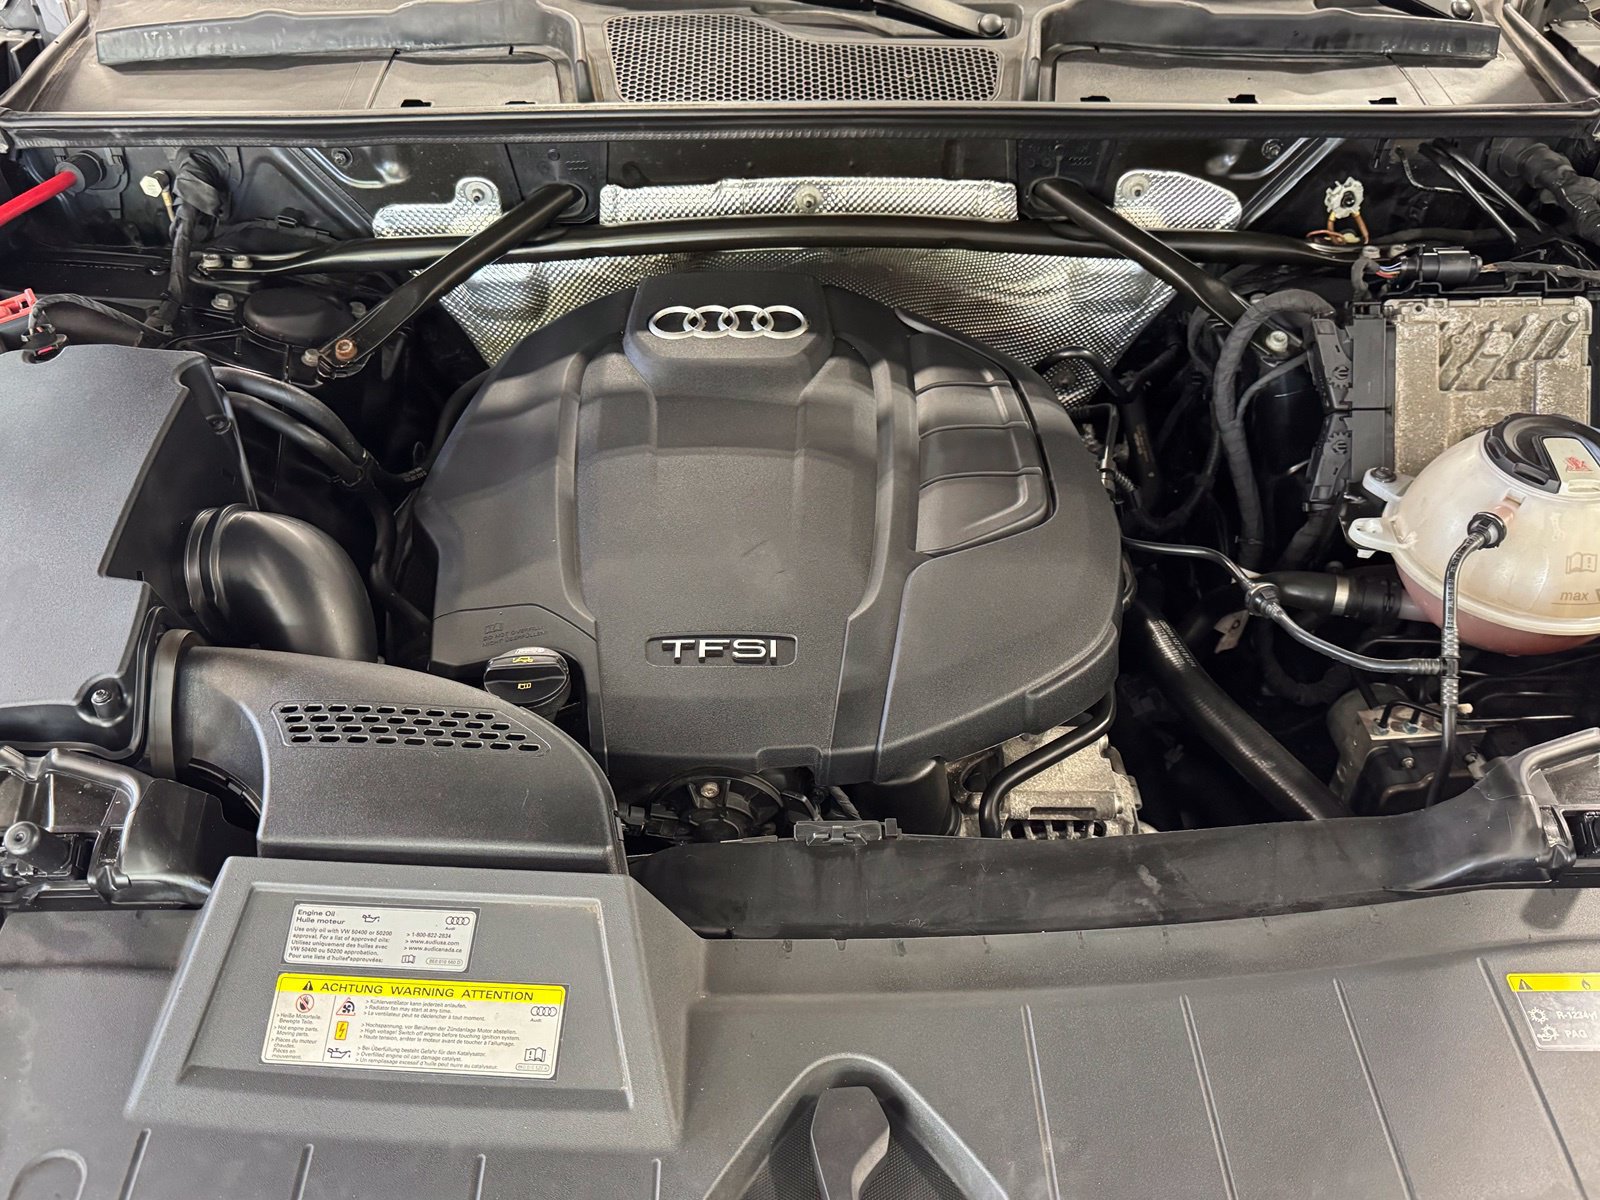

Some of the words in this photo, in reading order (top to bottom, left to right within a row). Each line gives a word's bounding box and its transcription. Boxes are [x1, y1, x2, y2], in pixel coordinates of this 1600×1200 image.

[1560, 590, 1589, 601] max
[661, 639, 778, 664] TFSI
[297, 909, 323, 917] Engine
[320, 983, 383, 993] ACHTUNG
[391, 986, 454, 998] WARNING
[462, 989, 533, 1000] ATTENTION
